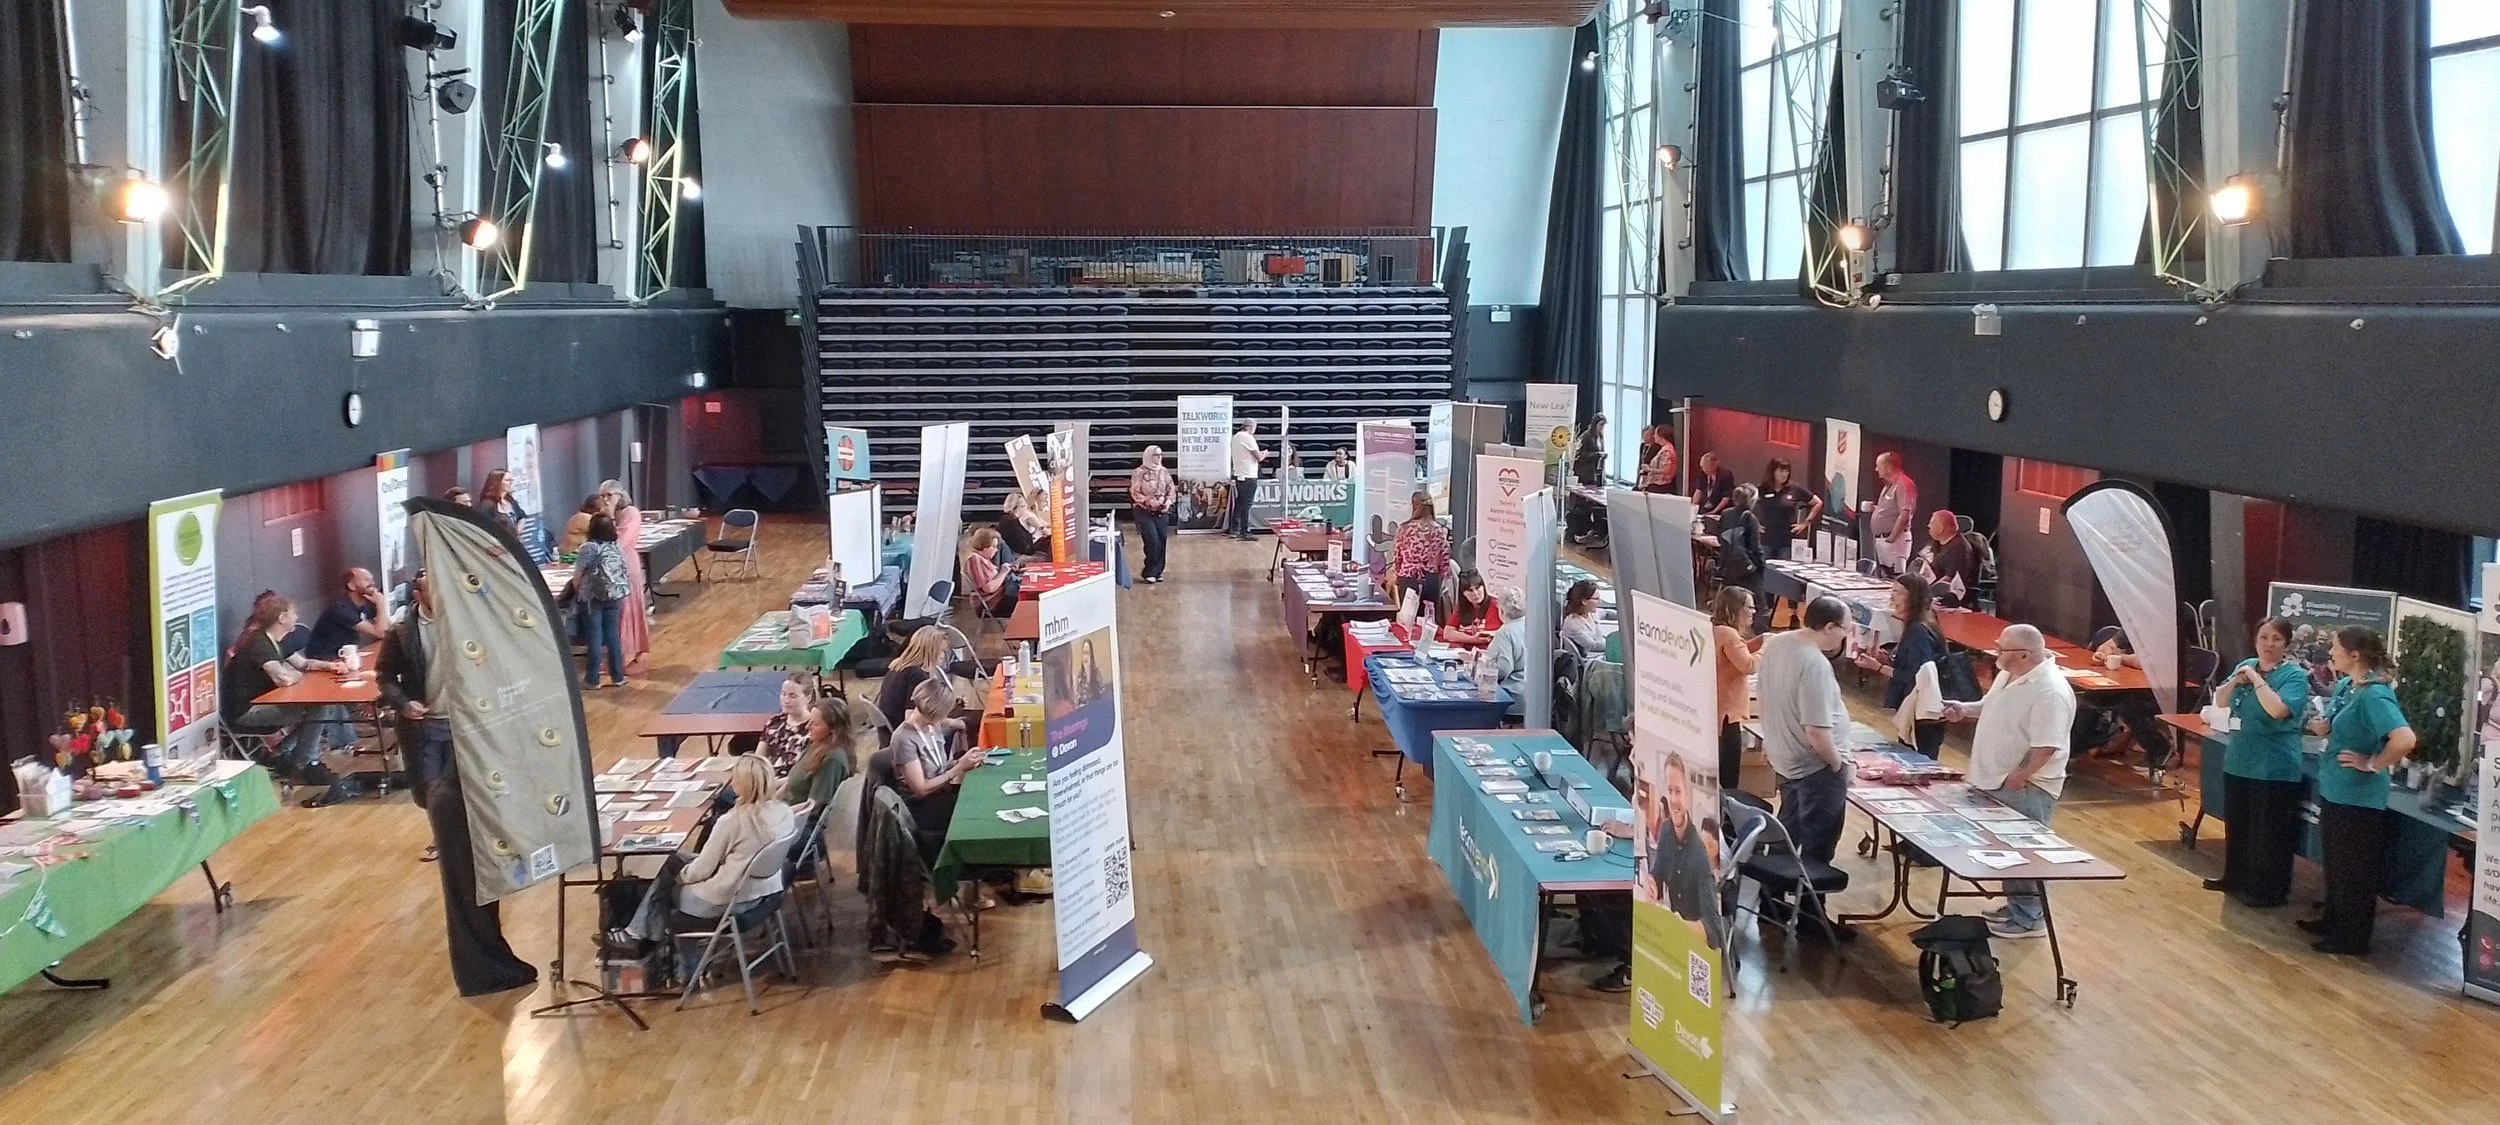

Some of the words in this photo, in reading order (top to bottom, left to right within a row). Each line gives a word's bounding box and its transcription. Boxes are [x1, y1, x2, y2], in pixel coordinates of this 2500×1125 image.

[1529, 401, 1548, 409] New
[1182, 411, 1229, 421] TALKWORKS
[1182, 427, 1198, 435] NEED
[1200, 427, 1208, 435] TO
[1211, 426, 1229, 435] TALK?
[1204, 436, 1221, 444] HERE
[1253, 484, 1348, 502] ALKWORKS
[2306, 601, 2341, 611] Disability
[2306, 609, 2340, 617] Together
[1044, 613, 1069, 637] mhm
[1637, 615, 1691, 652] learndevon
[1059, 738, 1078, 755] Devon
[2483, 881, 2500, 892] hav
